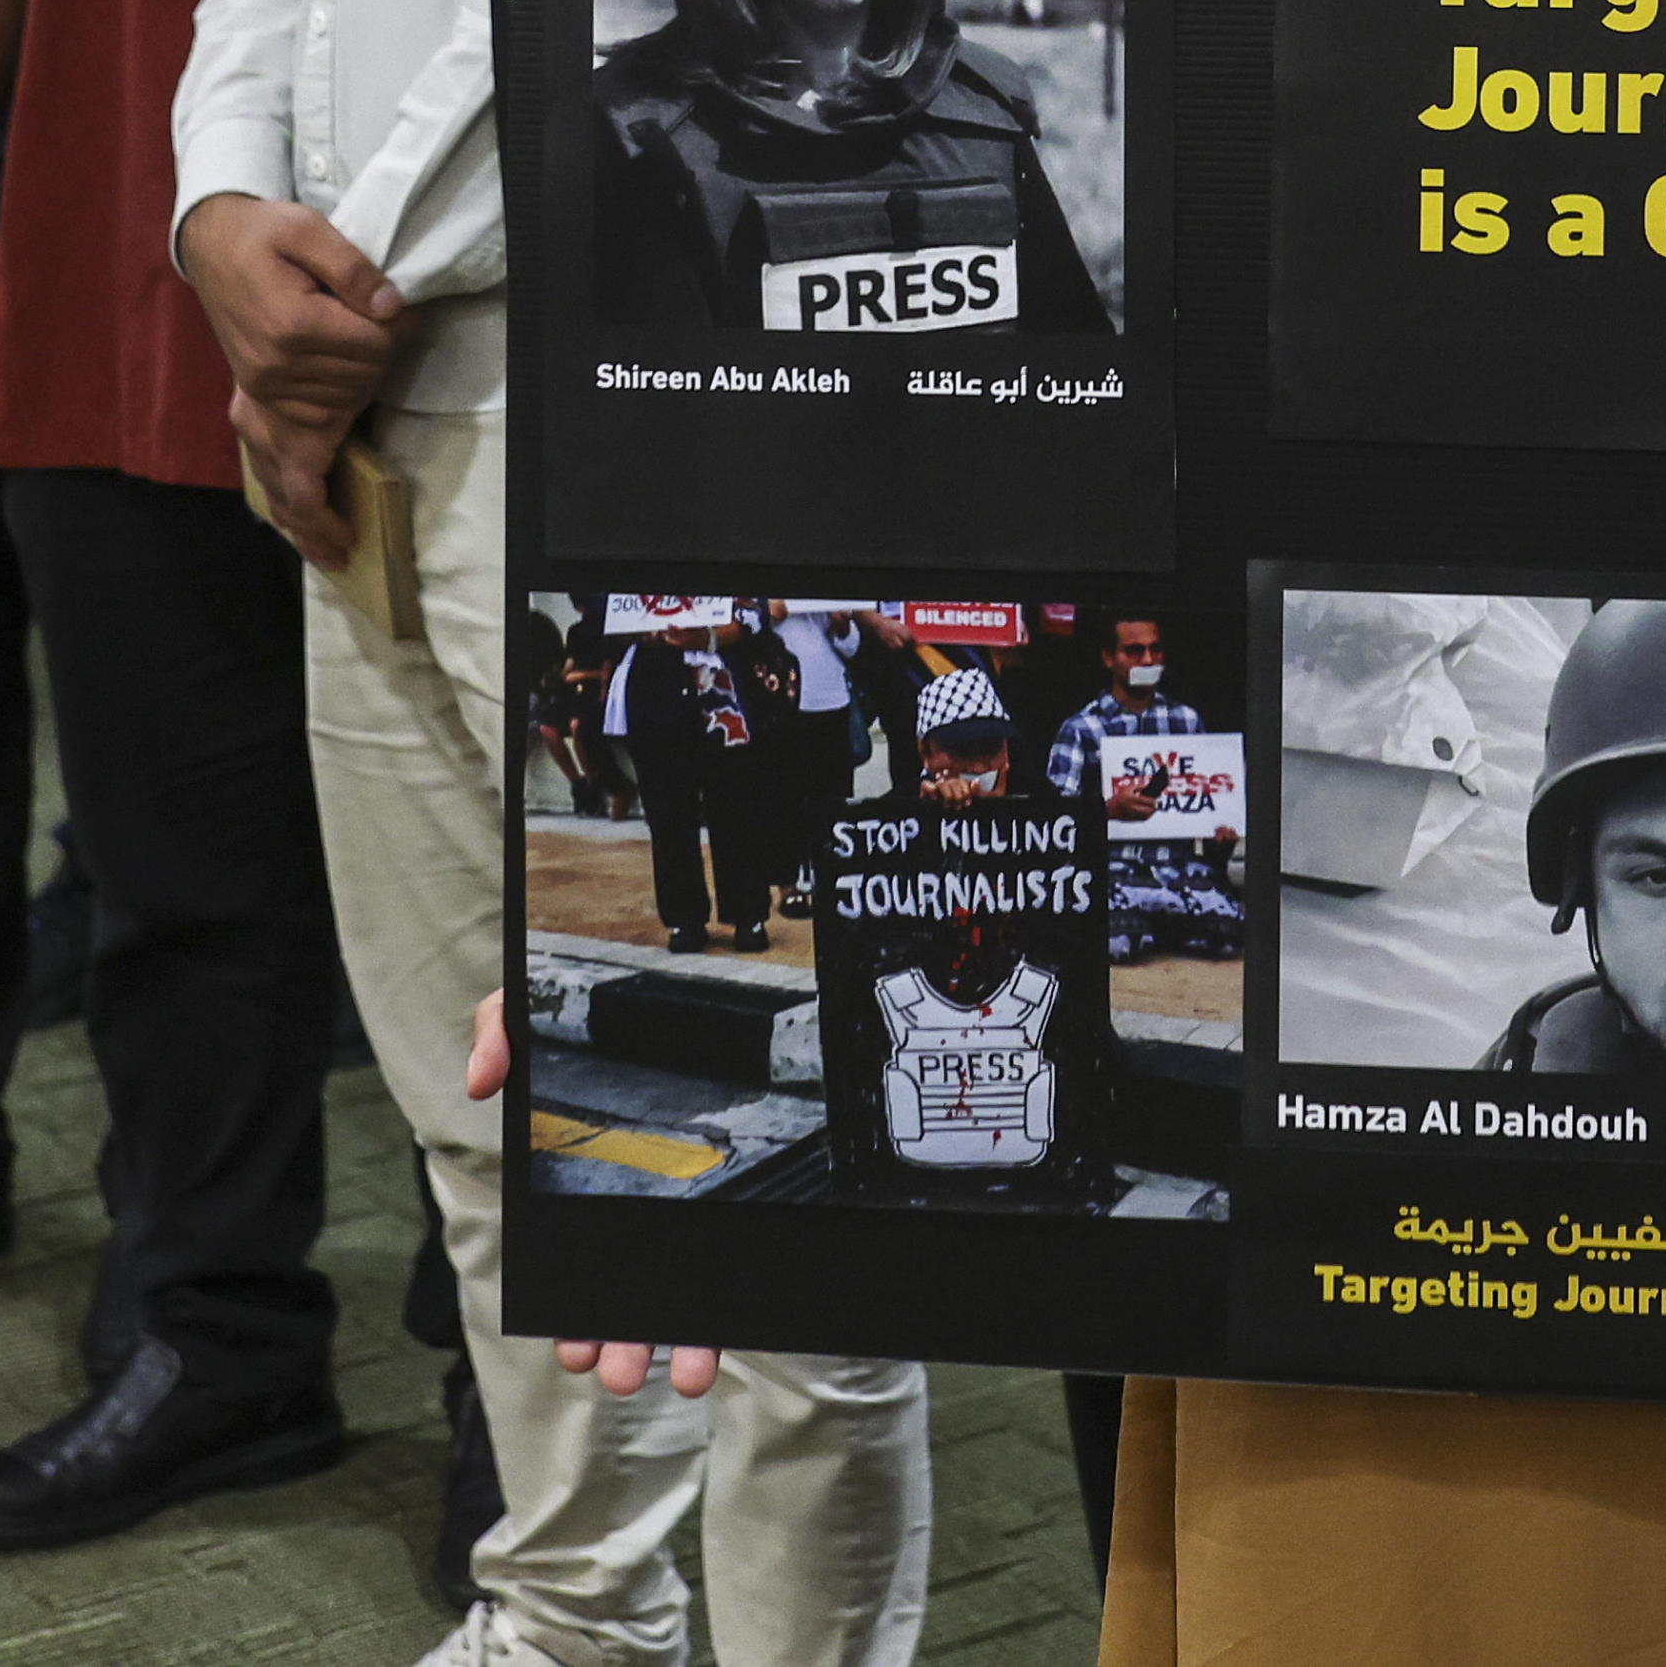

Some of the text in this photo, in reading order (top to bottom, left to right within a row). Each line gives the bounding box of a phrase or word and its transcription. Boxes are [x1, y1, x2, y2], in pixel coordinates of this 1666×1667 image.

[1419, 168, 1510, 255] is
[1547, 193, 1605, 257] a
[798, 254, 1001, 332] PRESS
[596, 363, 850, 394] Shireen Abu Akleh
[907, 365, 1124, 405] شيرين أبو عاقلة
[914, 608, 1008, 628] SILENCED
[1157, 792, 1216, 813] AZA
[832, 814, 1076, 857] STOP KILLING
[835, 865, 1094, 921] JOURNALISTS
[917, 1051, 1026, 1085] PRESS
[1277, 1093, 1648, 1142] Hamza Al Dahdouh
[1393, 1205, 1530, 1257] جريمة
[1313, 1263, 1538, 1319] Targeting
